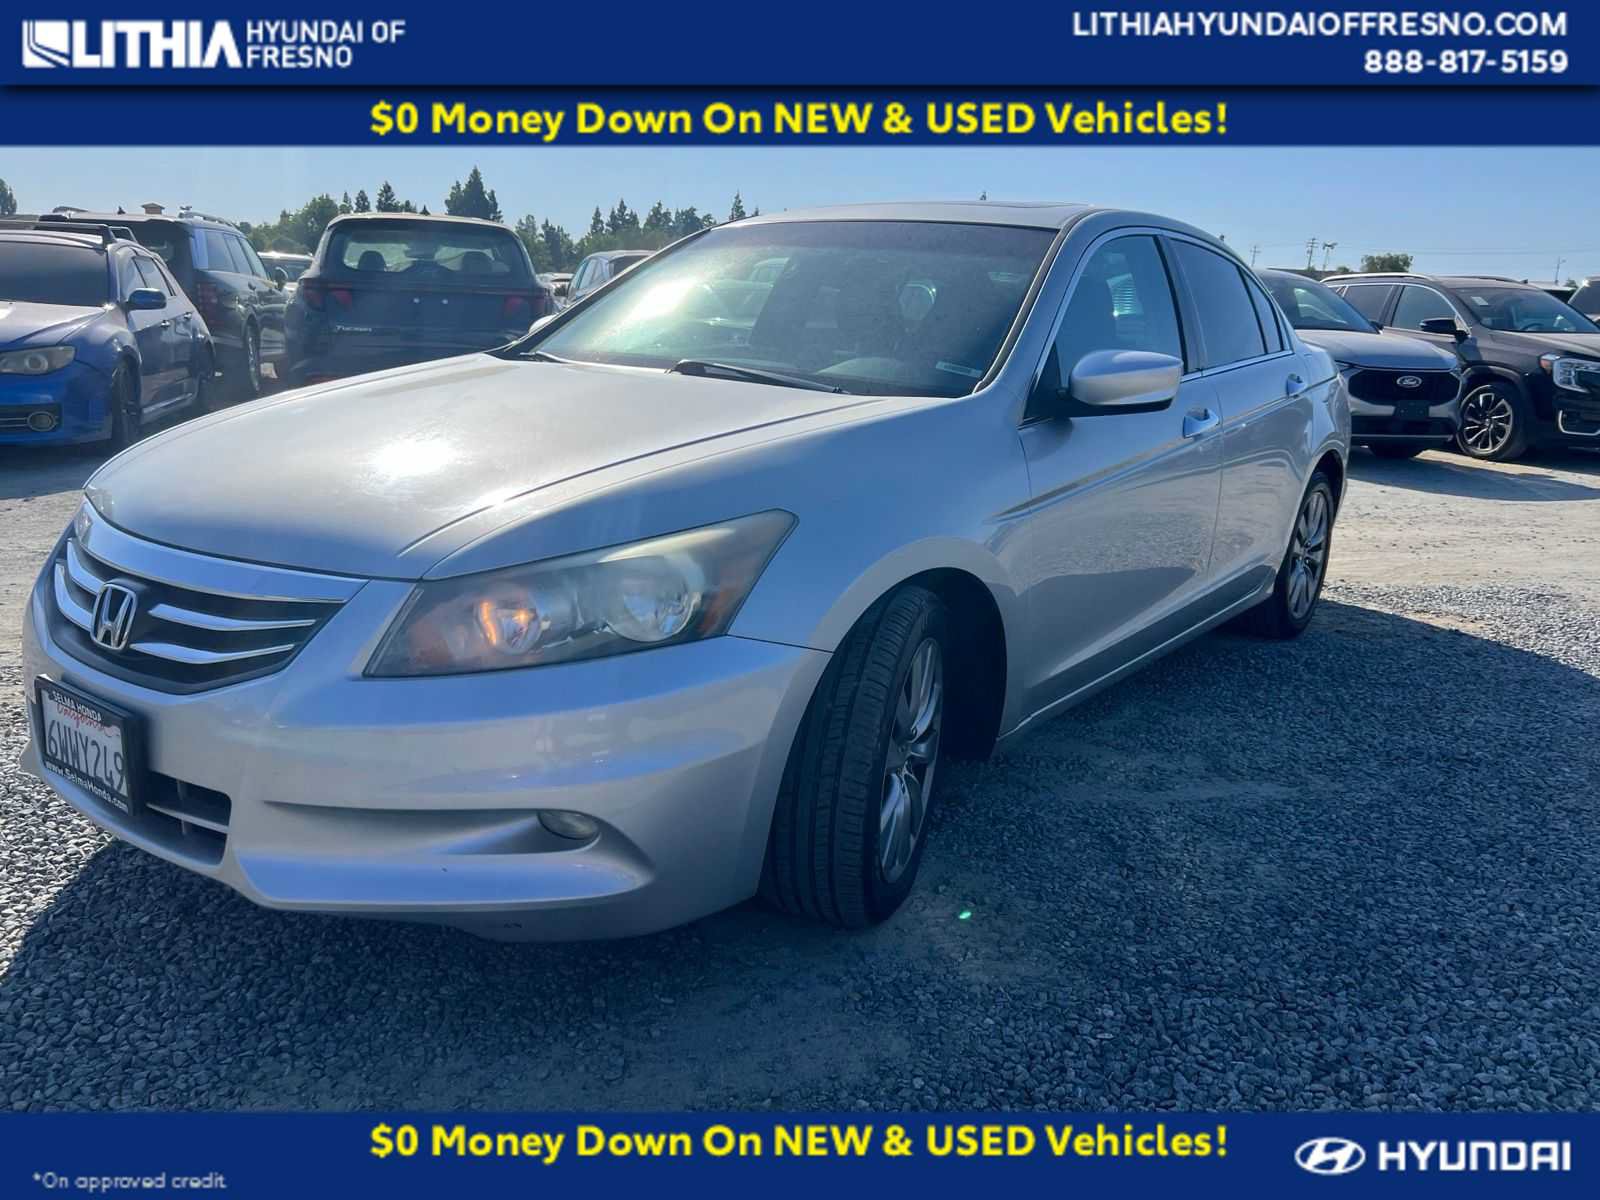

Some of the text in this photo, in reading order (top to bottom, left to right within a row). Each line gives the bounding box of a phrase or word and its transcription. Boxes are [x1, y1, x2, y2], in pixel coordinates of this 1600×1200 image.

[52, 690, 102, 722] SELMA HONDA
[48, 719, 124, 793] 6WWY249
